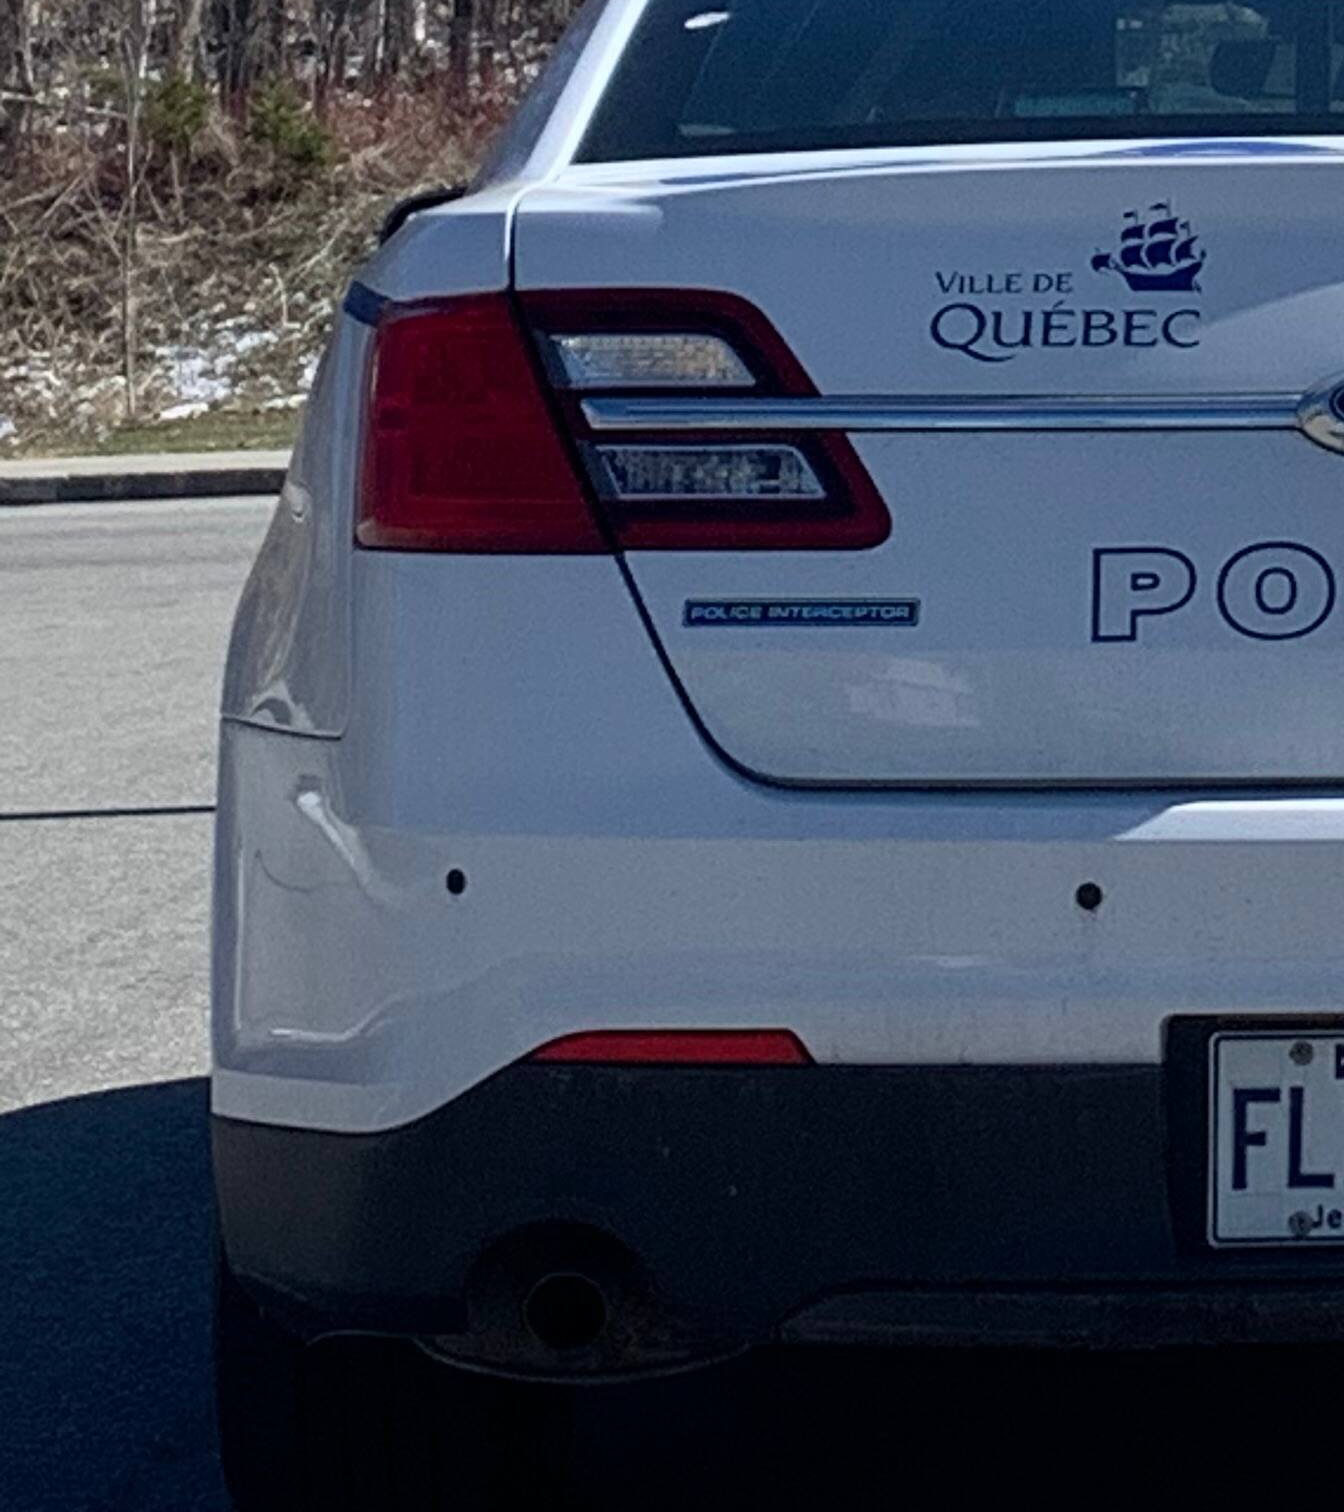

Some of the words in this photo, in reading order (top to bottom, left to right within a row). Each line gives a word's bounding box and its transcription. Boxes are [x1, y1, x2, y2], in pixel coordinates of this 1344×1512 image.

[934, 271, 1023, 294] VILLE
[1032, 271, 1074, 293] DE
[929, 300, 1202, 364] QUÉBEC
[690, 605, 763, 620] POLICE
[768, 604, 910, 619] INTERCEPTOR
[1311, 1204, 1344, 1230] Je
